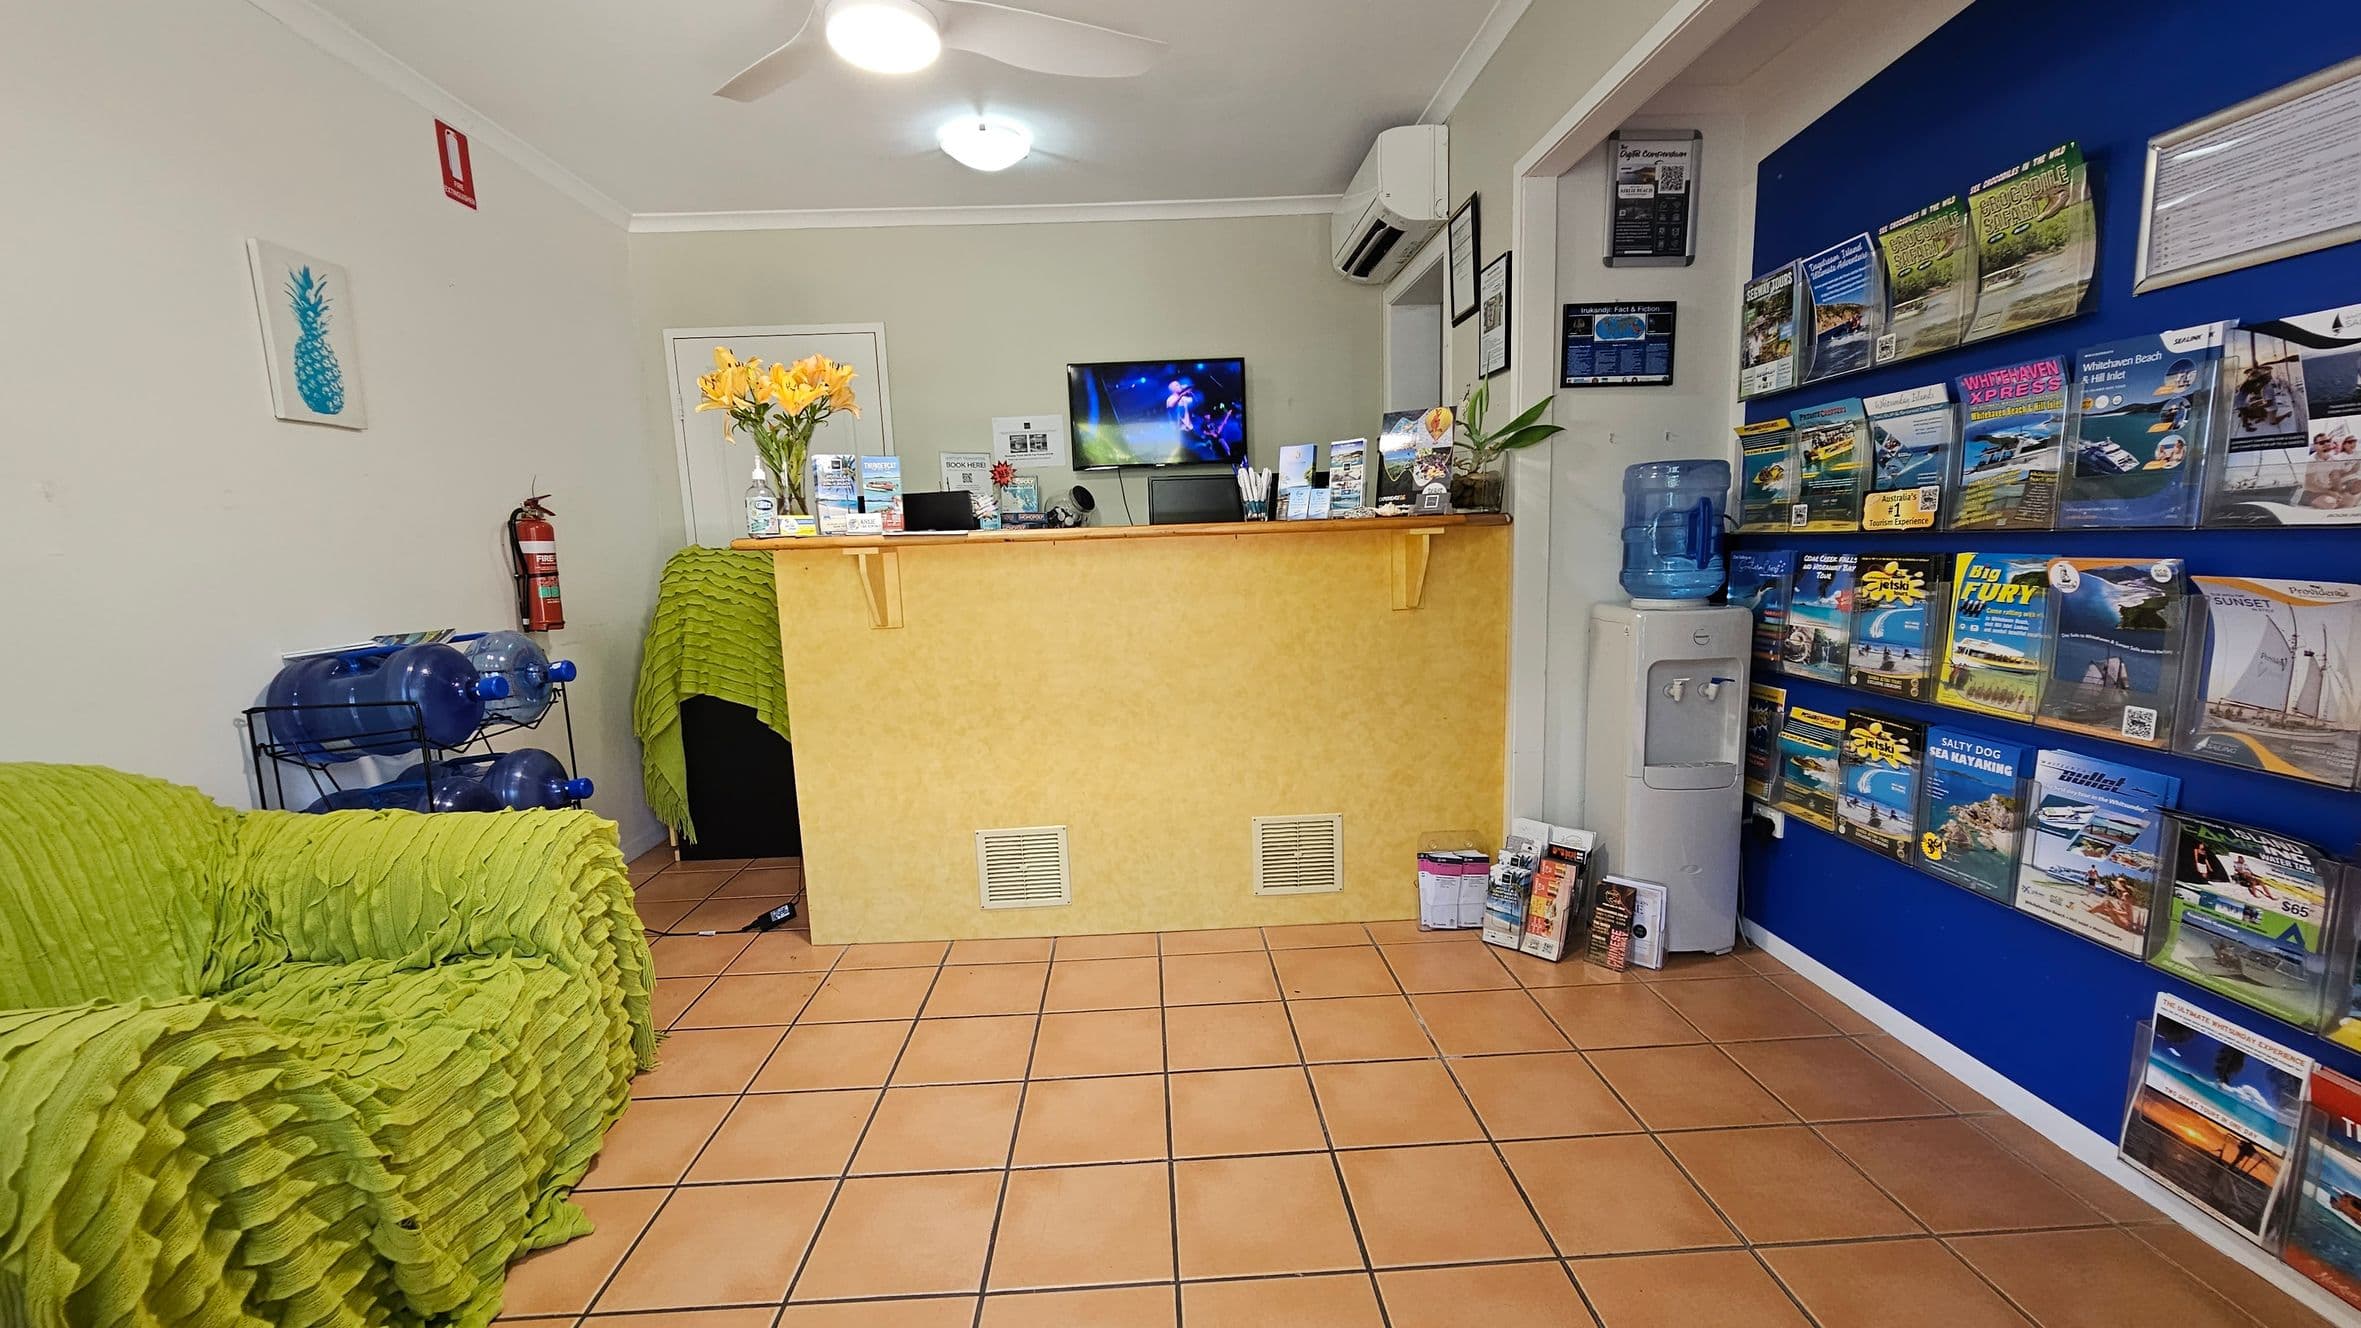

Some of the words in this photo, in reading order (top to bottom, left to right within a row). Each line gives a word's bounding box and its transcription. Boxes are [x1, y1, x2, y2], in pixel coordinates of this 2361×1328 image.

[1619, 150, 1642, 160] Digital
[1642, 150, 1687, 159] Compendium
[2033, 153, 2046, 166] THE
[2049, 145, 2067, 159] WILD
[1979, 163, 2070, 217] CROCODILE
[1929, 203, 1940, 213] THE
[1942, 195, 1956, 208] WILD
[1982, 202, 2040, 236] SAFARI
[1888, 210, 1961, 255] CROCODILE
[1841, 242, 1863, 259] Island
[1893, 238, 1940, 270] SAFARI
[1746, 278, 1772, 302] SEGWAY
[1770, 271, 1793, 296] TOURS
[2082, 357, 2133, 372] Whitehaven
[2135, 351, 2162, 364] Beach
[1962, 359, 2060, 391] WHITEHAVEN
[2081, 376, 2089, 384] &
[2091, 373, 2105, 383] Hill
[2106, 370, 2126, 381] Inlet
[1969, 377, 2063, 405] XPRESS
[1970, 408, 2006, 422] Whitehaven
[2006, 405, 2027, 416] Beach
[1881, 492, 1917, 503] Australia's
[1888, 503, 1901, 518] #1
[1869, 518, 1894, 527] Tourism
[1894, 517, 1929, 527] Experience
[1838, 555, 1858, 563] FALLS
[1842, 564, 1856, 572] BAY
[1816, 571, 1832, 579] TOUR
[1968, 564, 2002, 583] Big
[1879, 580, 1910, 591] jetski
[1960, 581, 2039, 605] FURY
[2214, 597, 2270, 608] SUNSET
[1865, 738, 1895, 754] jetski
[1941, 737, 1973, 752] SALTY
[1975, 745, 2001, 759] DOG
[1929, 746, 1949, 760] SEA
[1950, 752, 2013, 777] KAYAKING
[2229, 827, 2304, 855] ISLAND
[2258, 852, 2294, 869] WATER
[2294, 862, 2316, 874] TAXI
[2281, 900, 2310, 918] $65
[1606, 928, 1622, 967] CHINESE
[2162, 998, 2176, 1010] THE
[2177, 1003, 2211, 1023] ULTIMATE
[2211, 1017, 2257, 1044] WHITSUNDAY
[2257, 1041, 2305, 1067] EXPERIENCE
[2243, 1128, 2258, 1139] DAY
